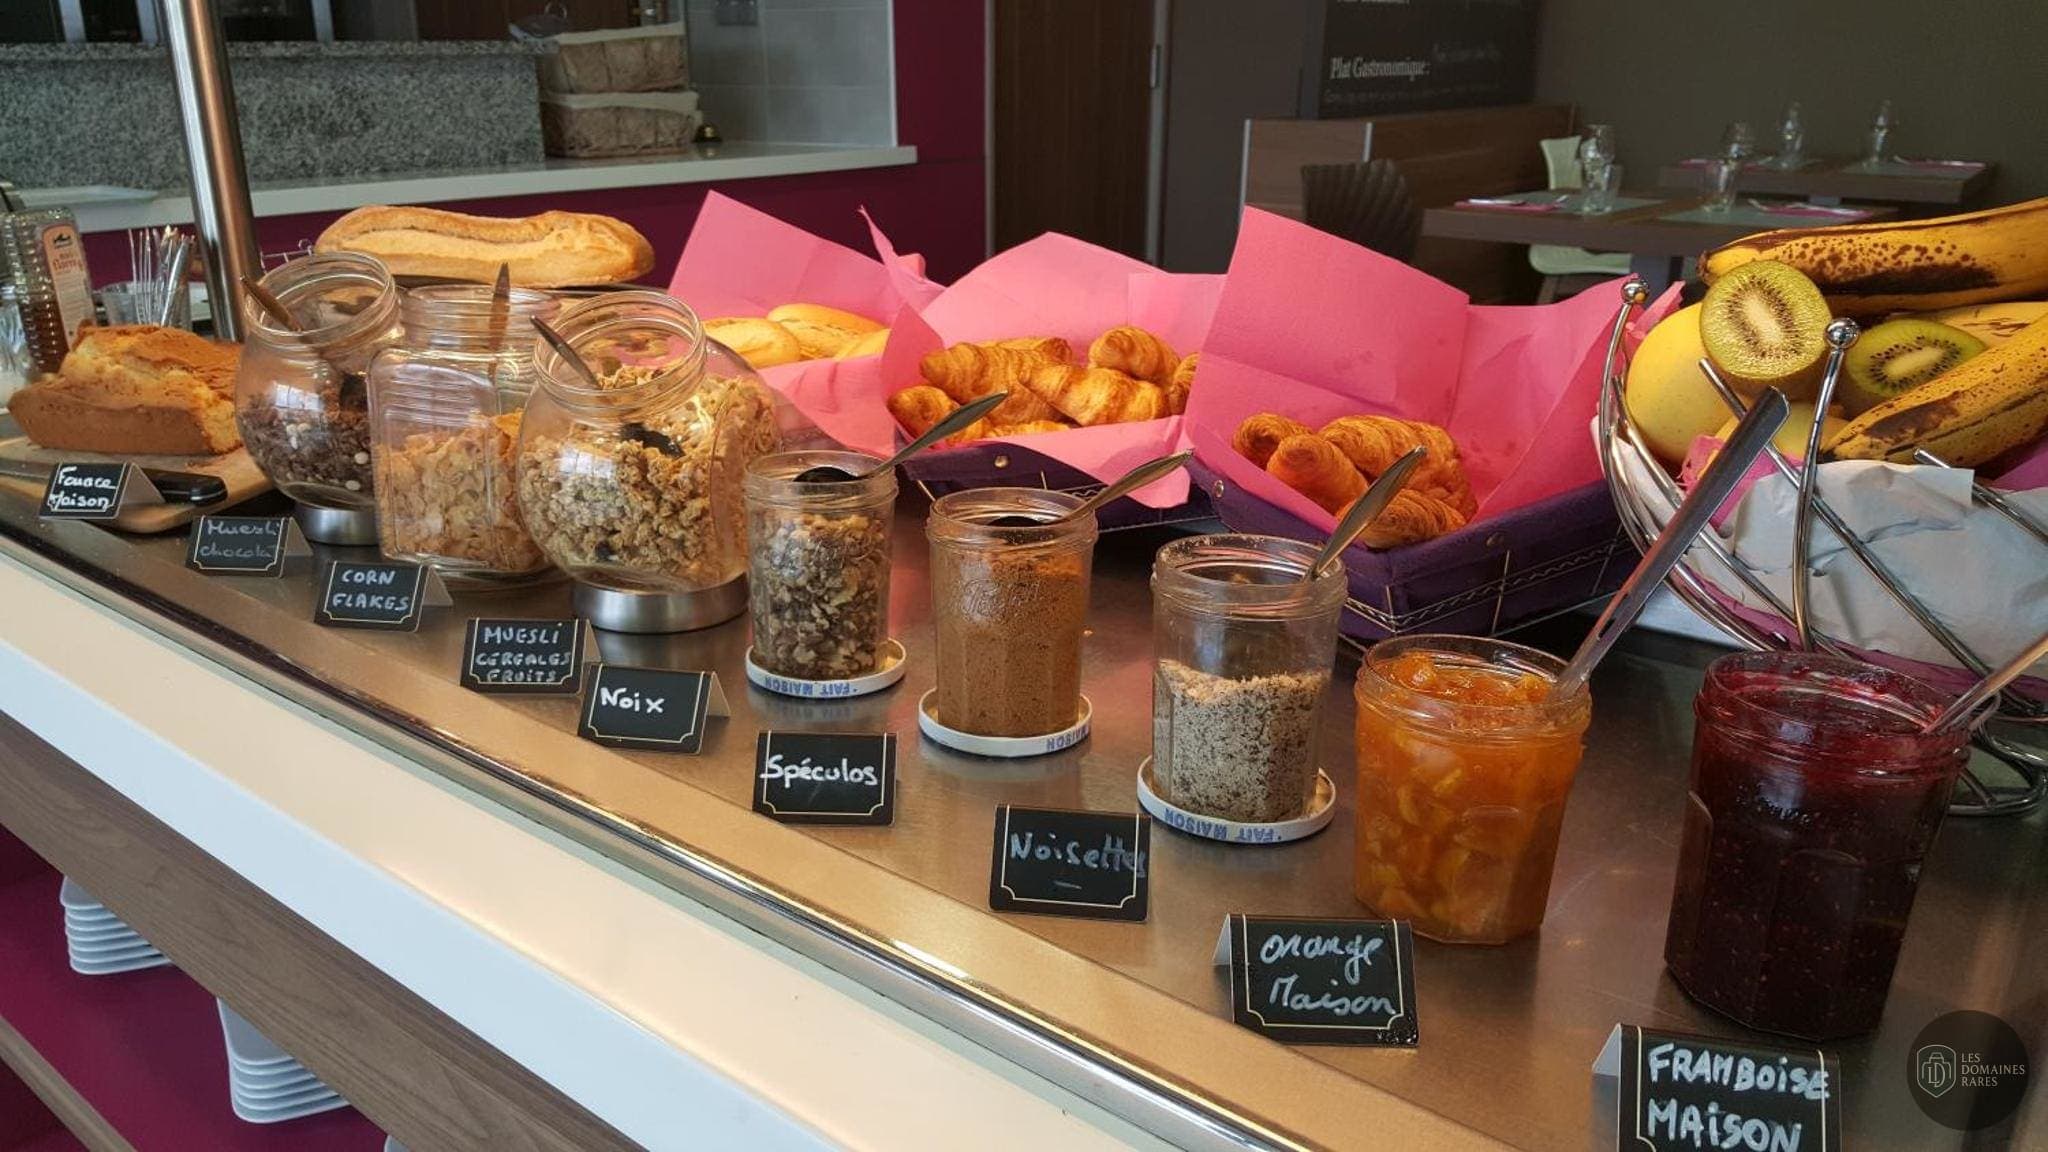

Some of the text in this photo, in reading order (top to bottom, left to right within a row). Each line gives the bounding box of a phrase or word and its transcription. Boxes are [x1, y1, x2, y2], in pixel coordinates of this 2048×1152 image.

[341, 569, 396, 585] CORN
[332, 593, 409, 611] FLAKES
[764, 676, 850, 696] FAIT MAISON
[600, 687, 665, 713] Noix
[760, 754, 878, 789] Spéculos
[1164, 807, 1274, 842] FAIT MAISON
[1269, 973, 1396, 1015] Maison
